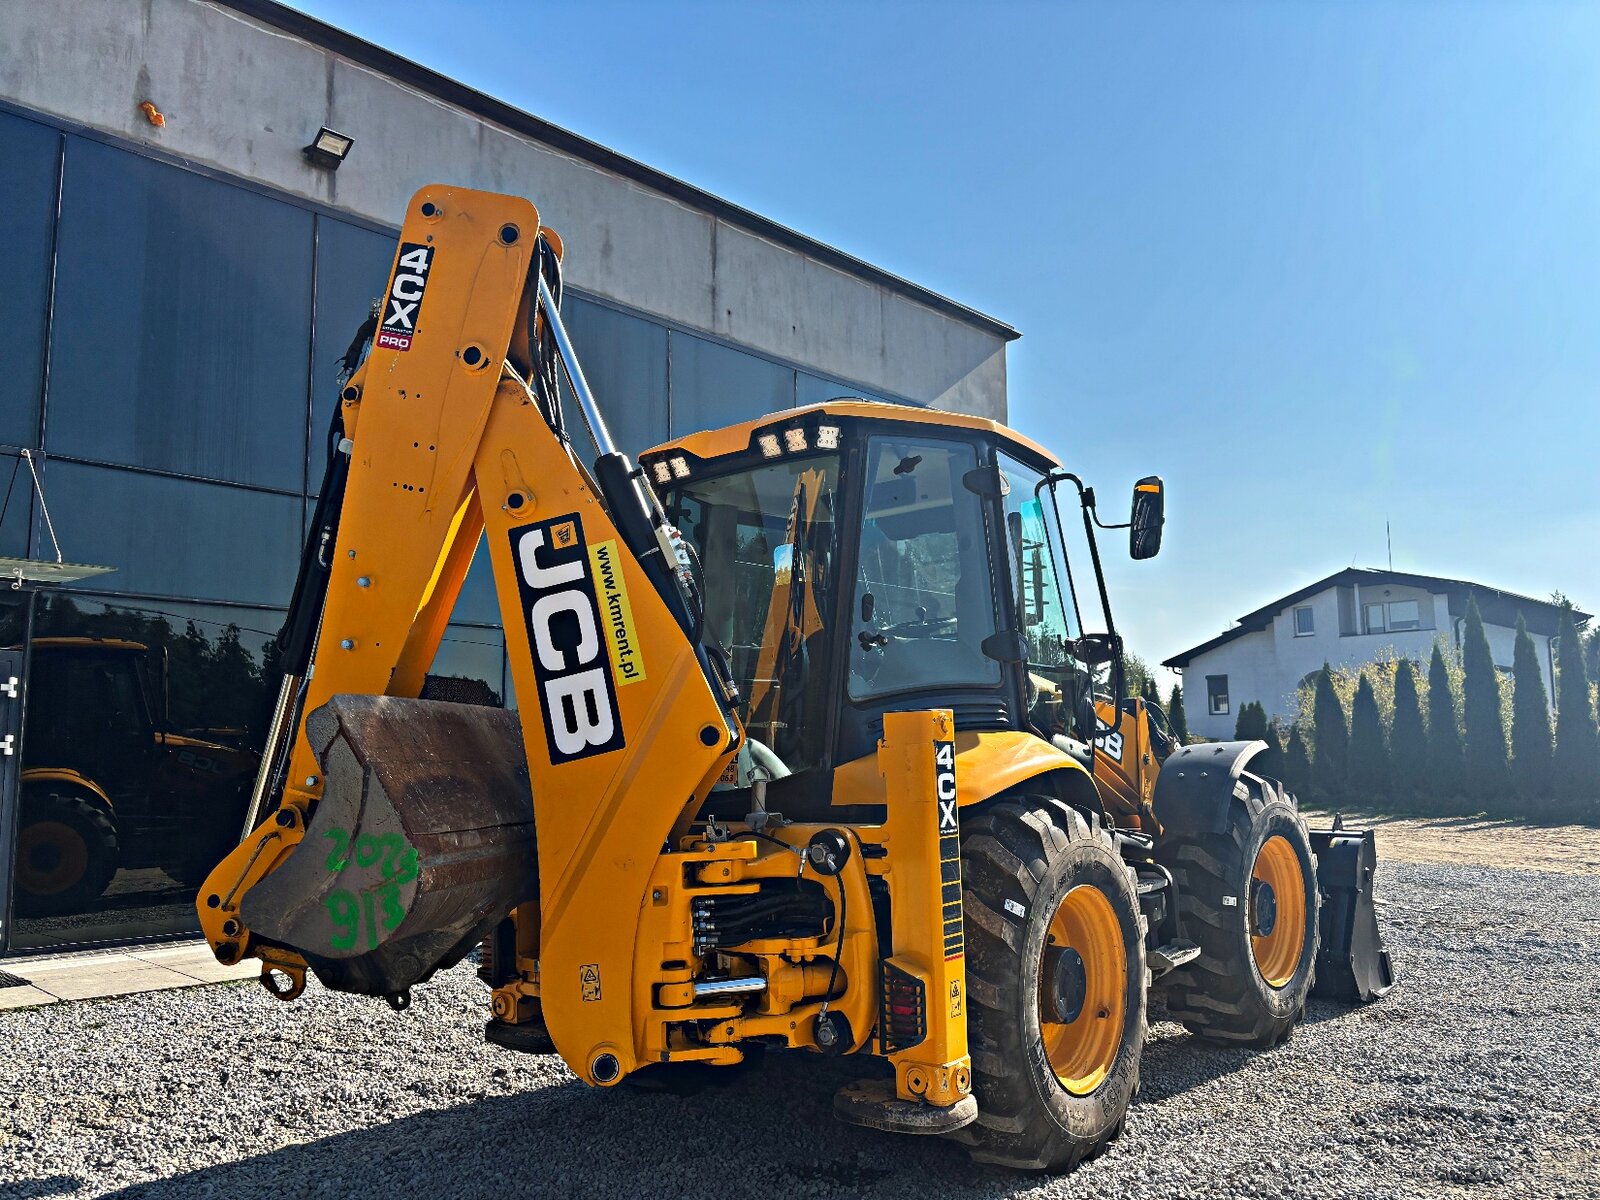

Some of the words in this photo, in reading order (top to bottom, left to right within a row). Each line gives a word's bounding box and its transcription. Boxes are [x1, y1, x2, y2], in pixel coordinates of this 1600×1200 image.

[384, 248, 429, 328] 4CX
[379, 335, 410, 348] PRO
[518, 529, 615, 755] JCB
[596, 546, 640, 680] www.kmrent.pl
[936, 744, 958, 828] 4CX
[321, 827, 418, 884] 2023
